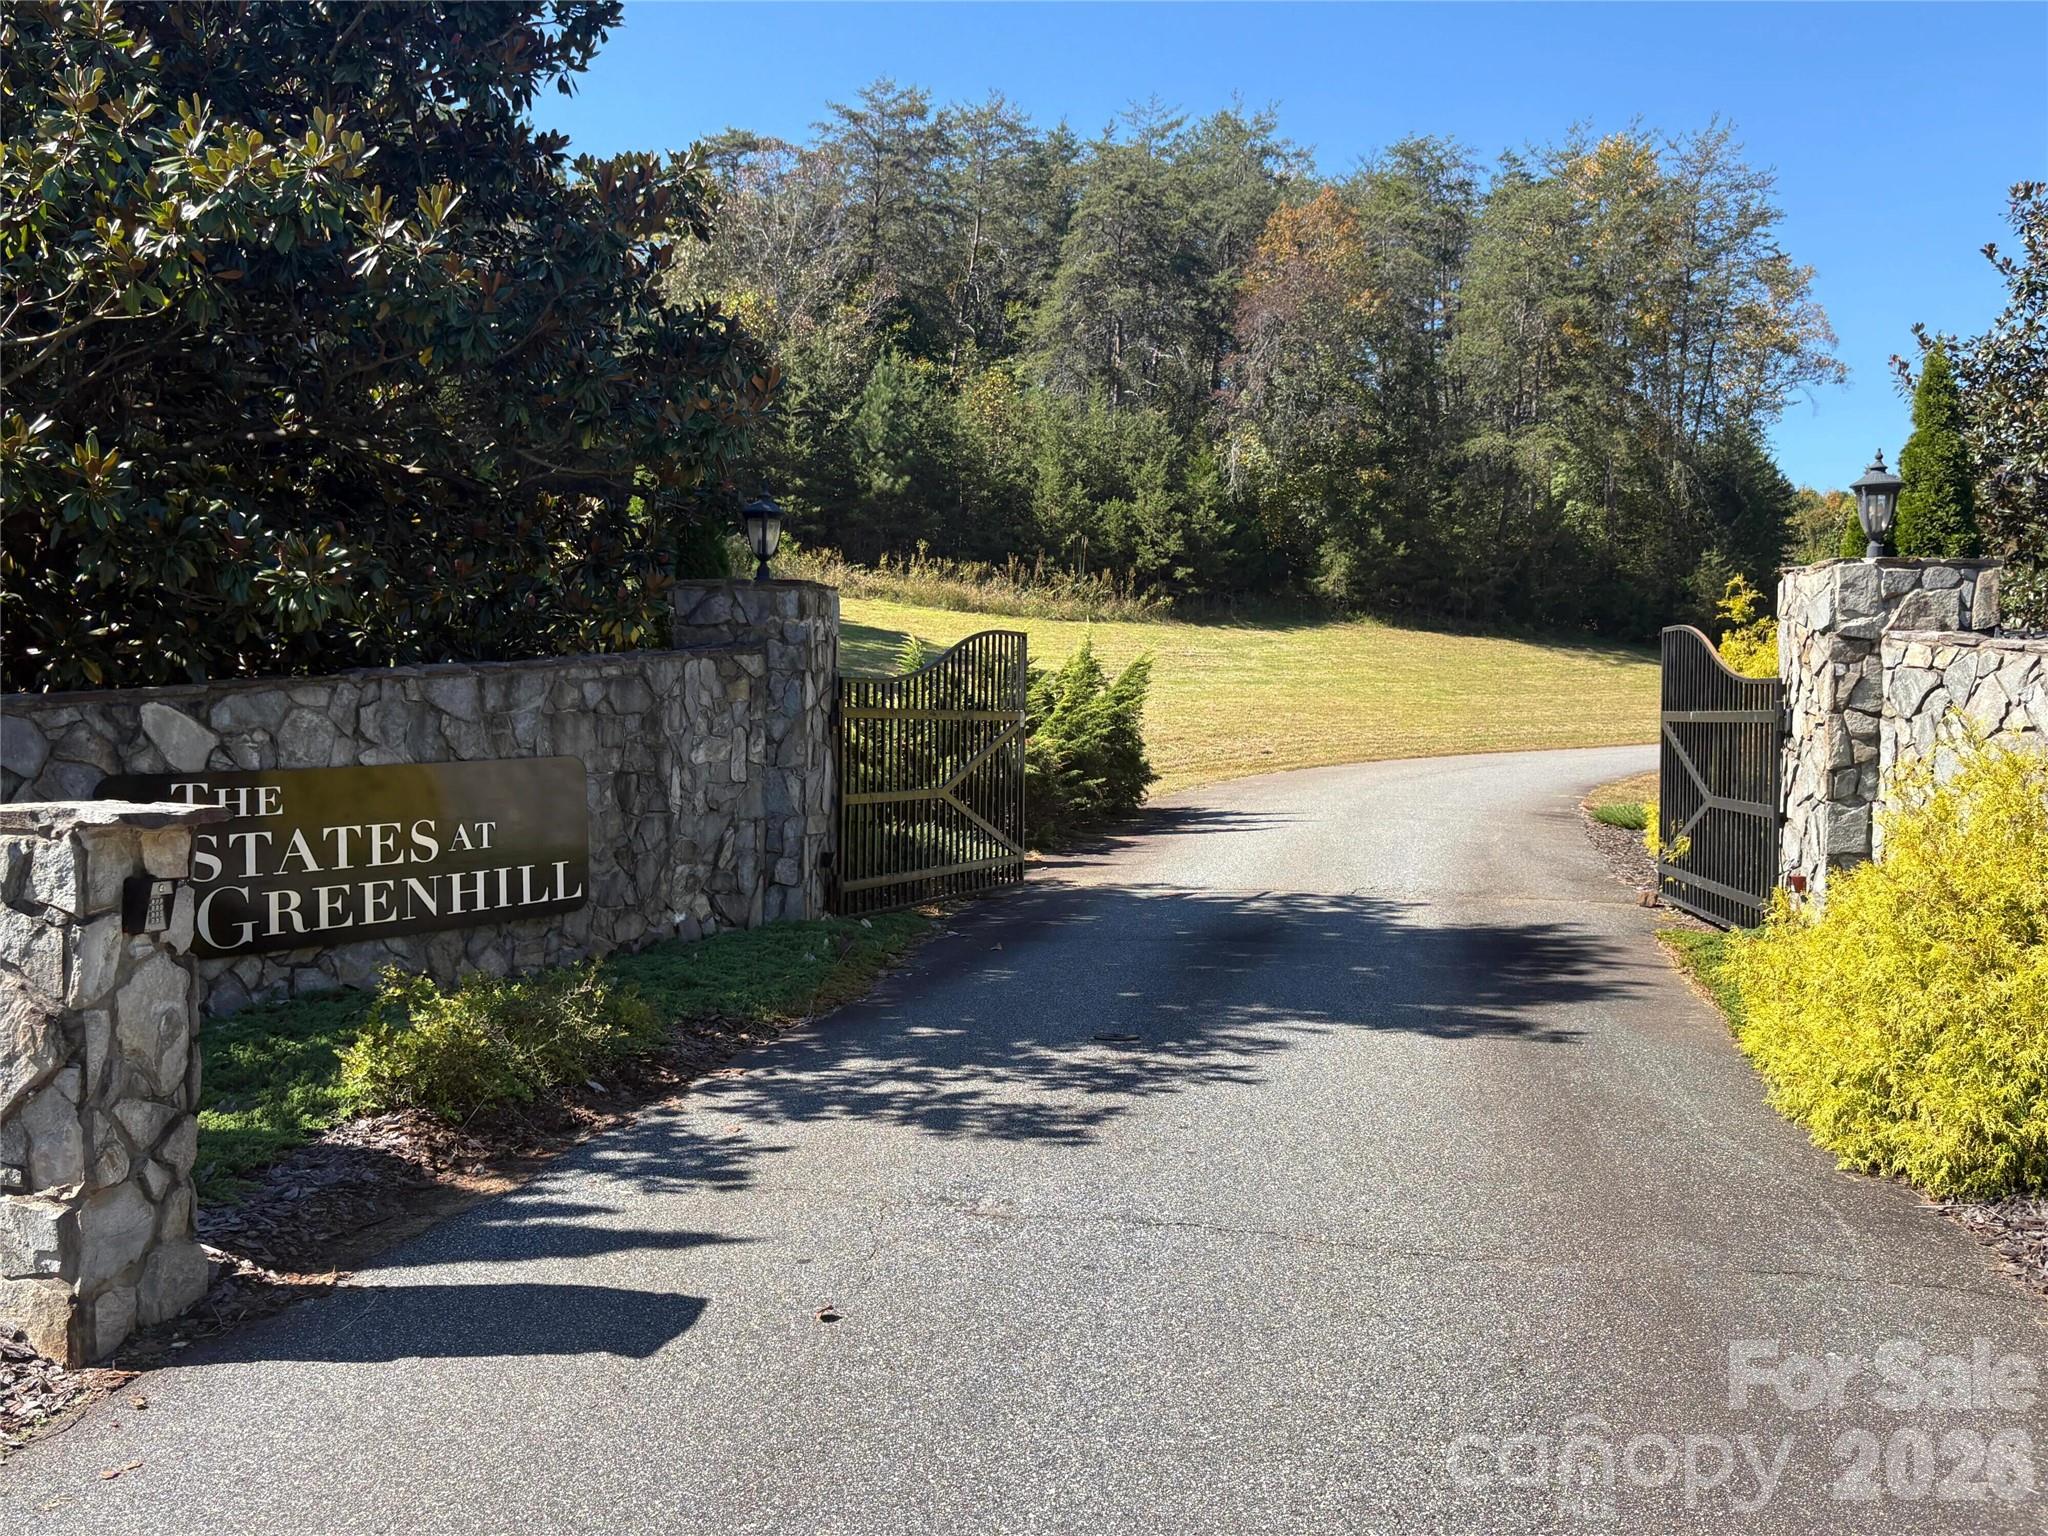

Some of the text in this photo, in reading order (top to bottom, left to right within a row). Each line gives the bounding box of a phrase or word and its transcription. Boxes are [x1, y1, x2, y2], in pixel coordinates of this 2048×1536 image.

[171, 782, 284, 817] THE
[448, 821, 497, 852] AT
[199, 861, 583, 949] GREENHILL
